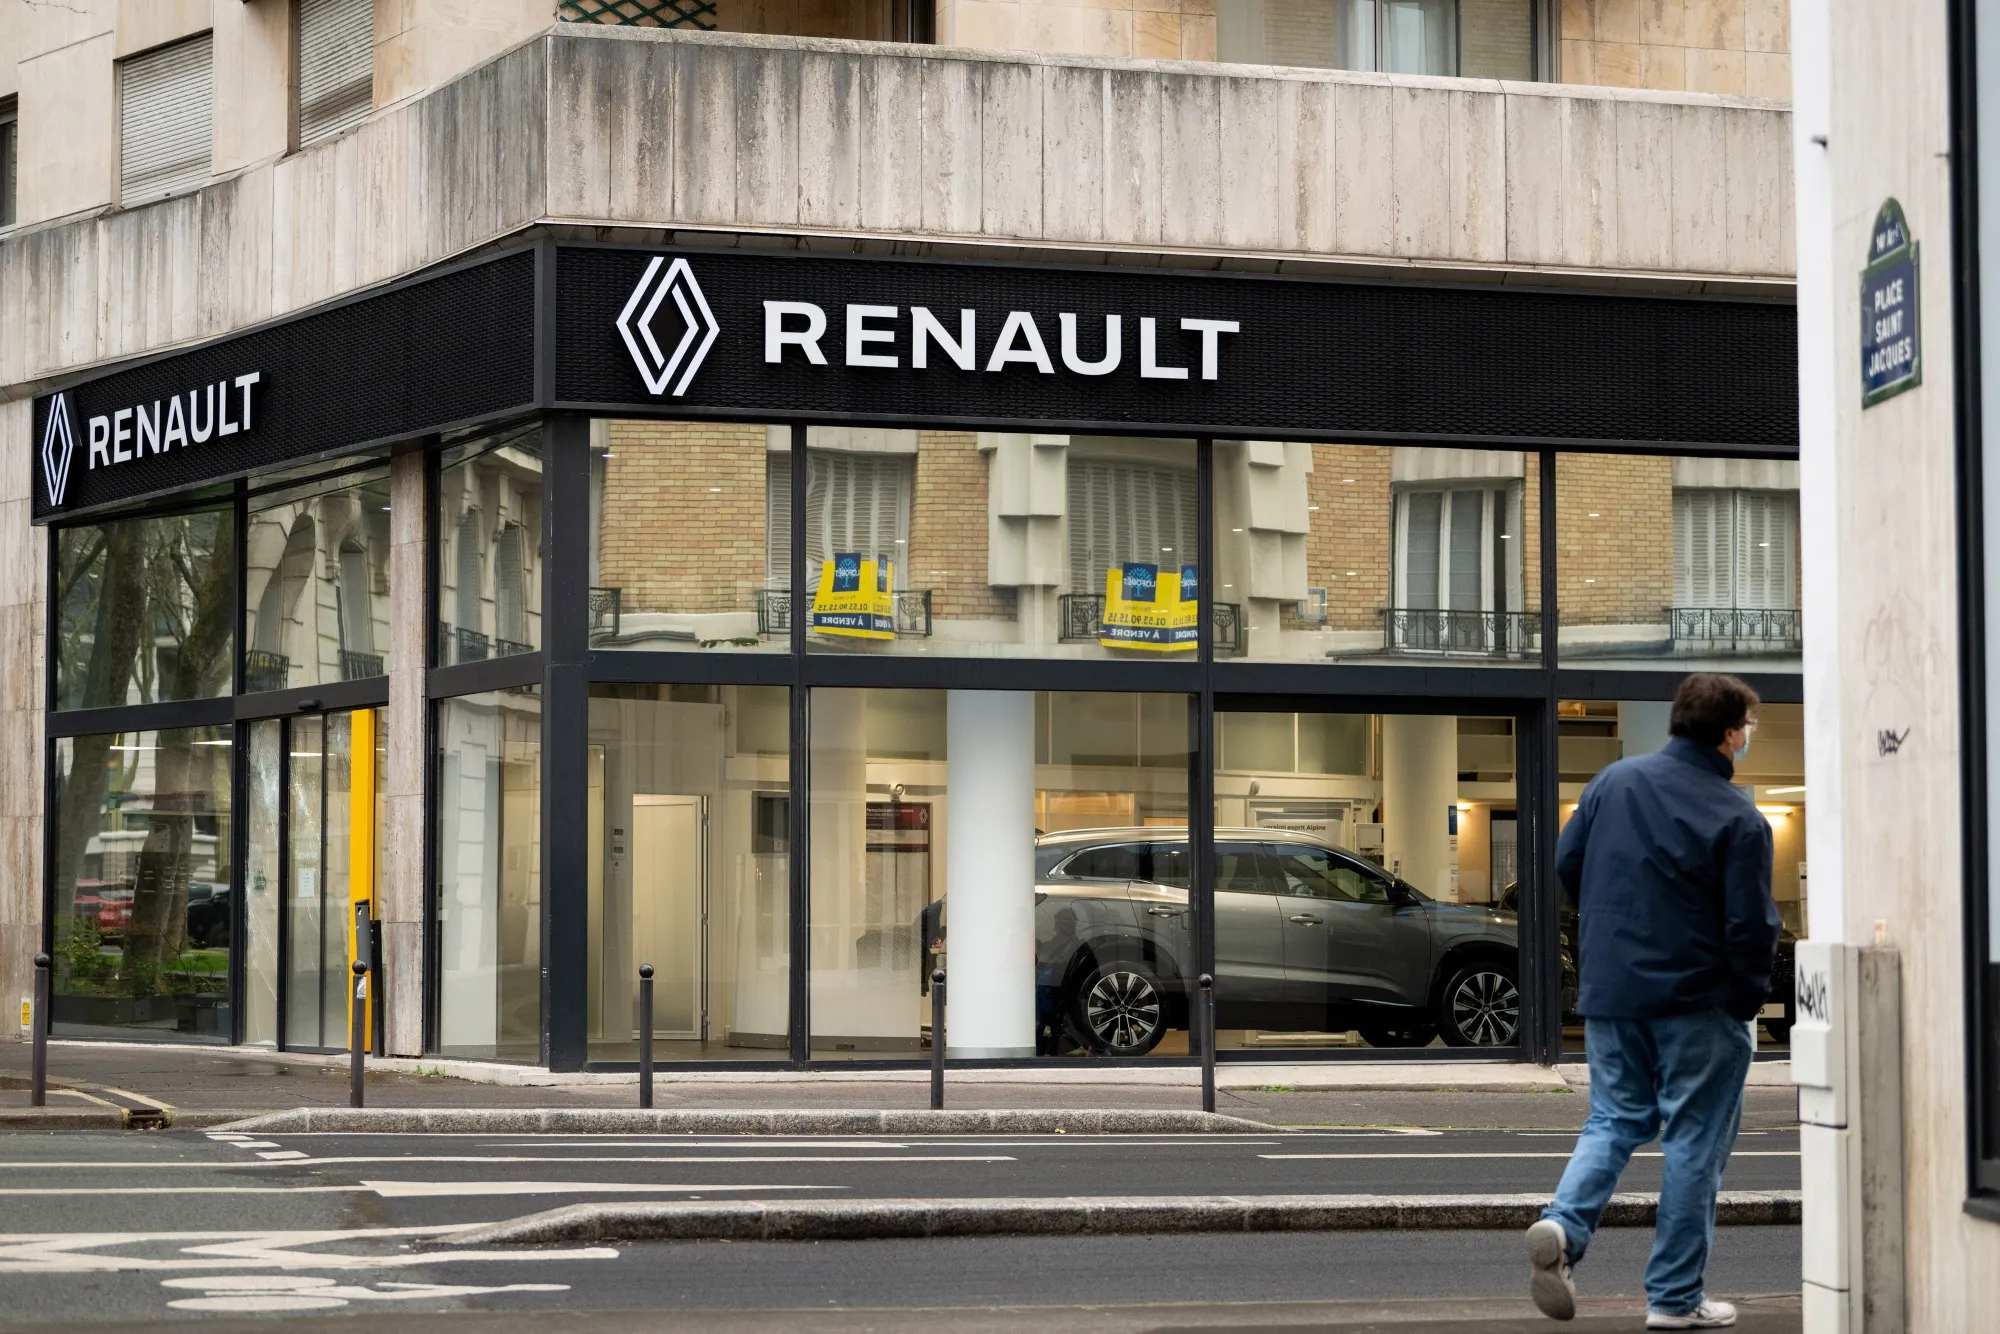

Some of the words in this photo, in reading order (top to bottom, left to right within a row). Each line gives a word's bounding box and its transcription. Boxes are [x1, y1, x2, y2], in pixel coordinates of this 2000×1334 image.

[1875, 278, 1904, 314] PLACE
[762, 300, 1240, 381] RENAULT
[1875, 309, 1904, 344] SAINT
[1869, 336, 1912, 378] JACQUES
[89, 371, 260, 470] RENAULT
